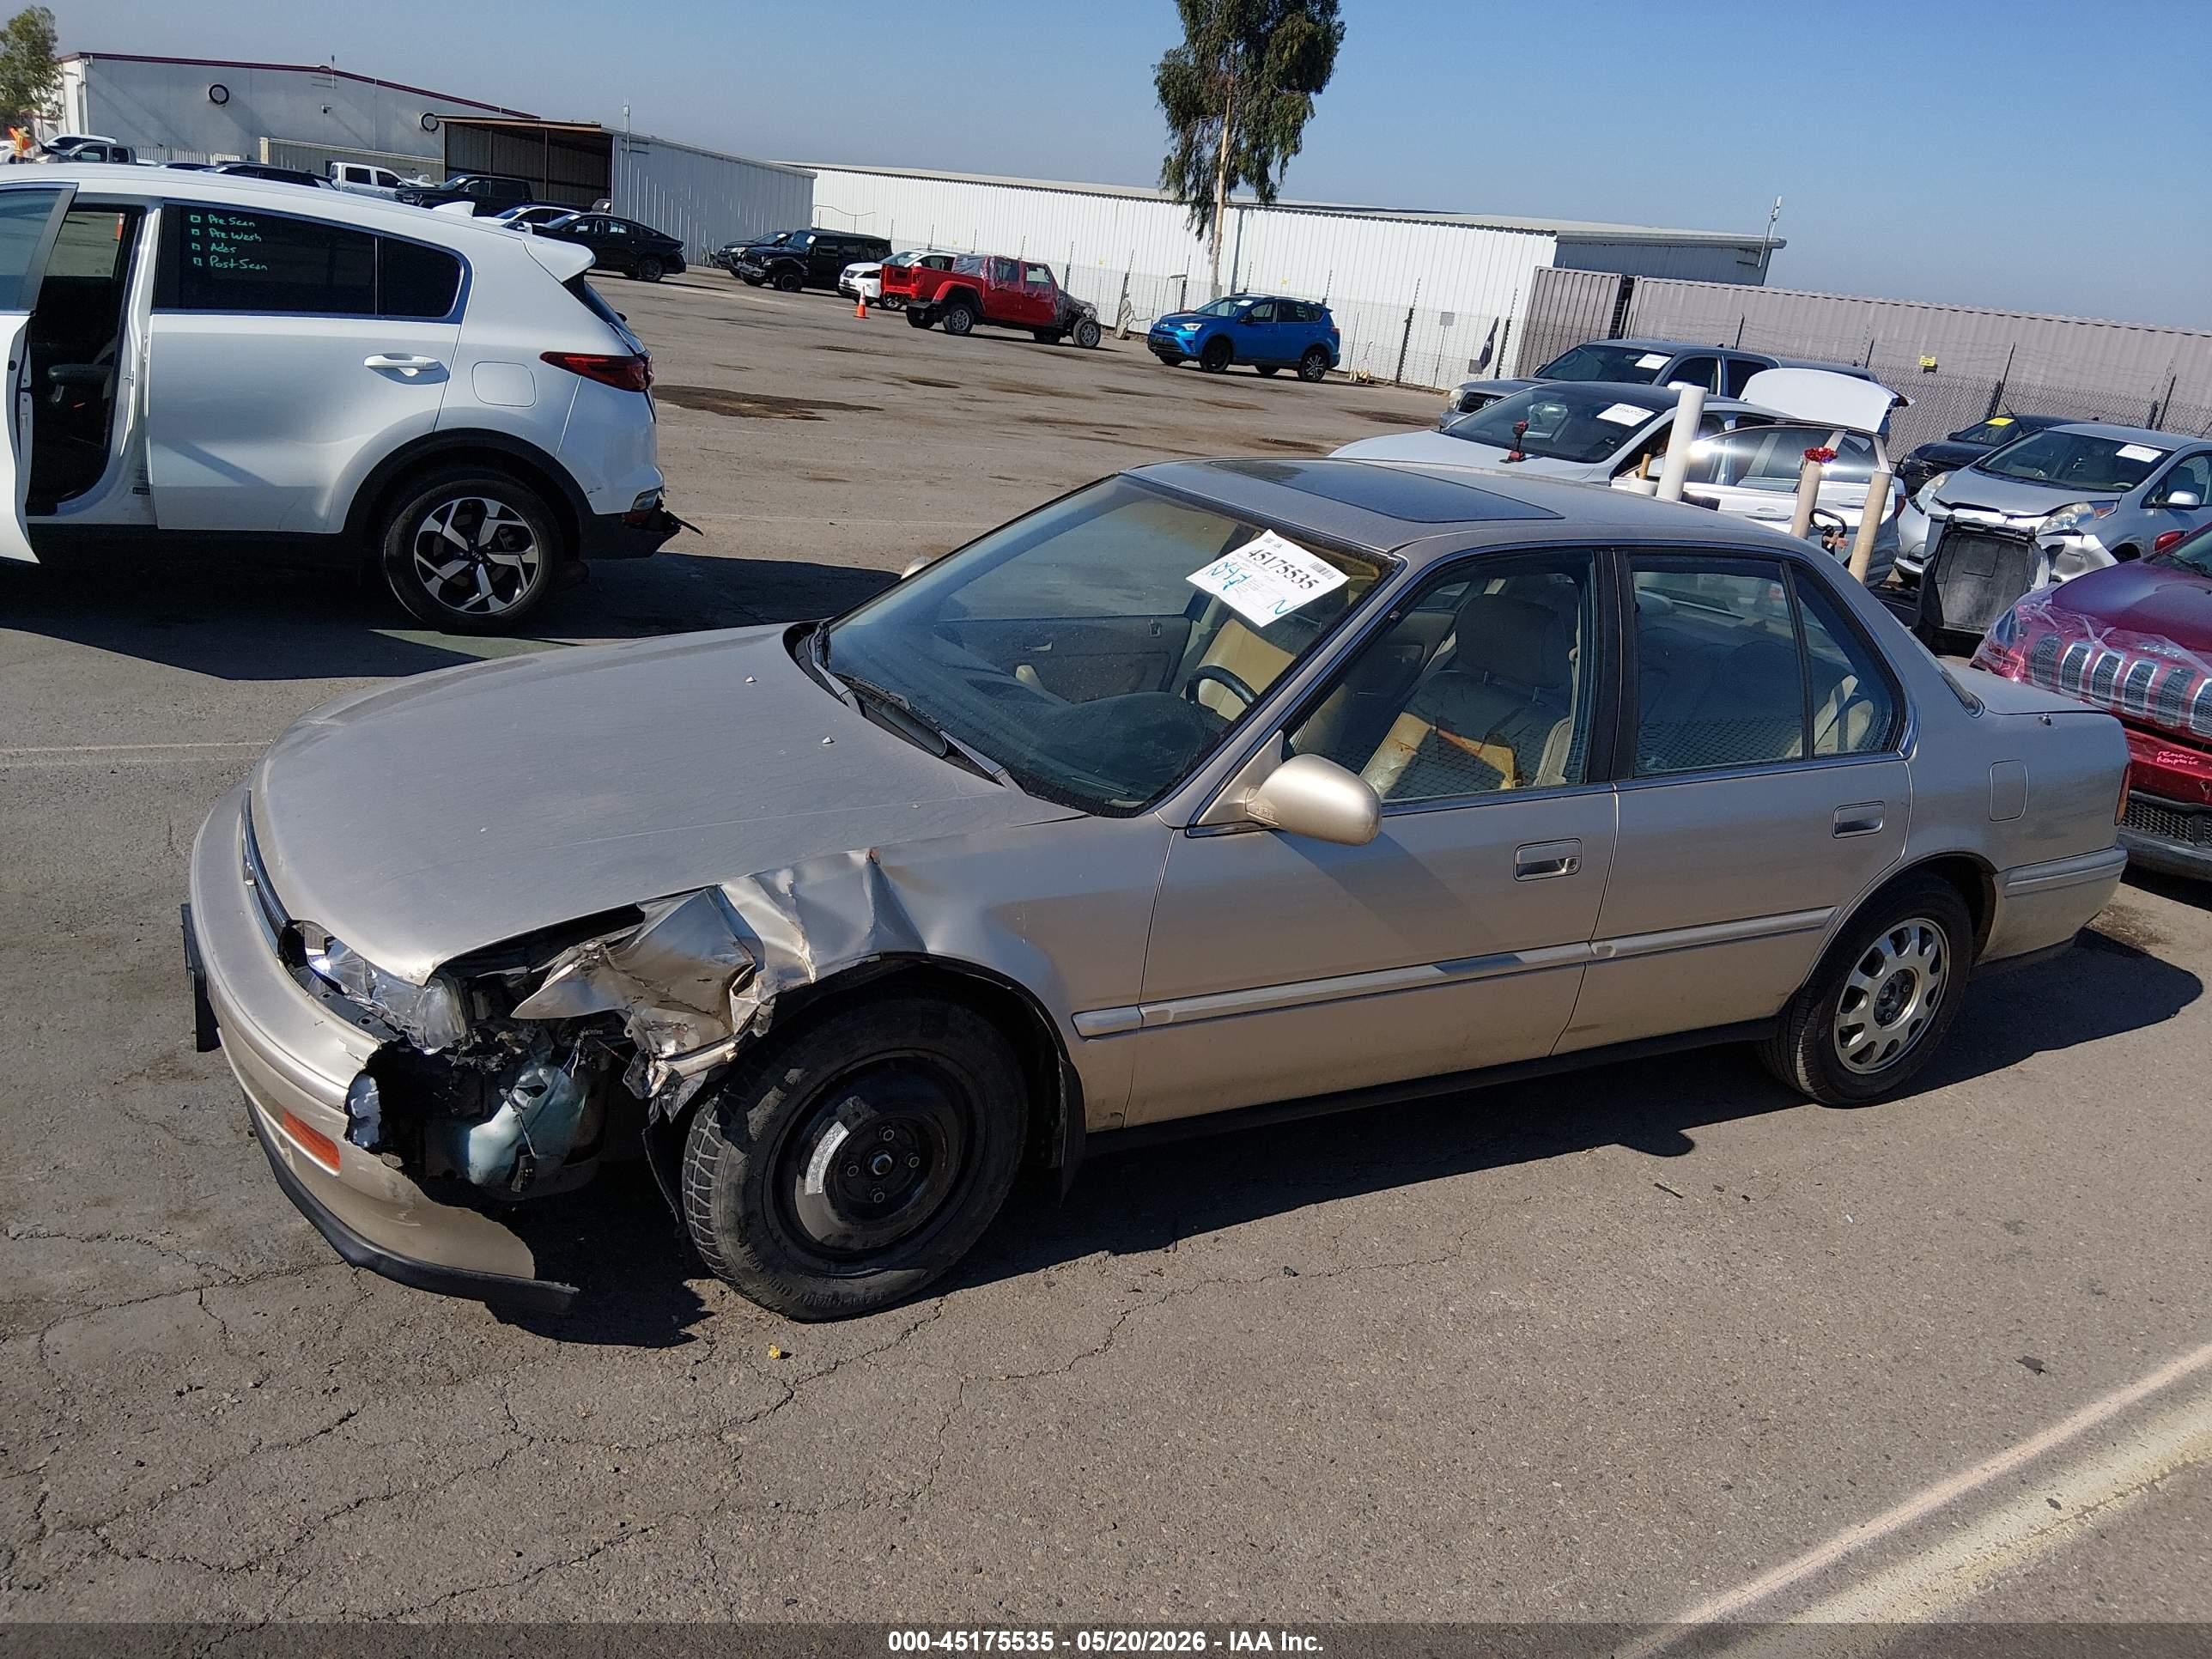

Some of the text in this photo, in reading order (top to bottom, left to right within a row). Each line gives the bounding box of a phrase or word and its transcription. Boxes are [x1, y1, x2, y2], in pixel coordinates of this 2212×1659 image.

[228, 216, 255, 228] Scan
[230, 231, 262, 242] Wash
[239, 258, 268, 271] Scan
[1247, 548, 1321, 590] 45175535
